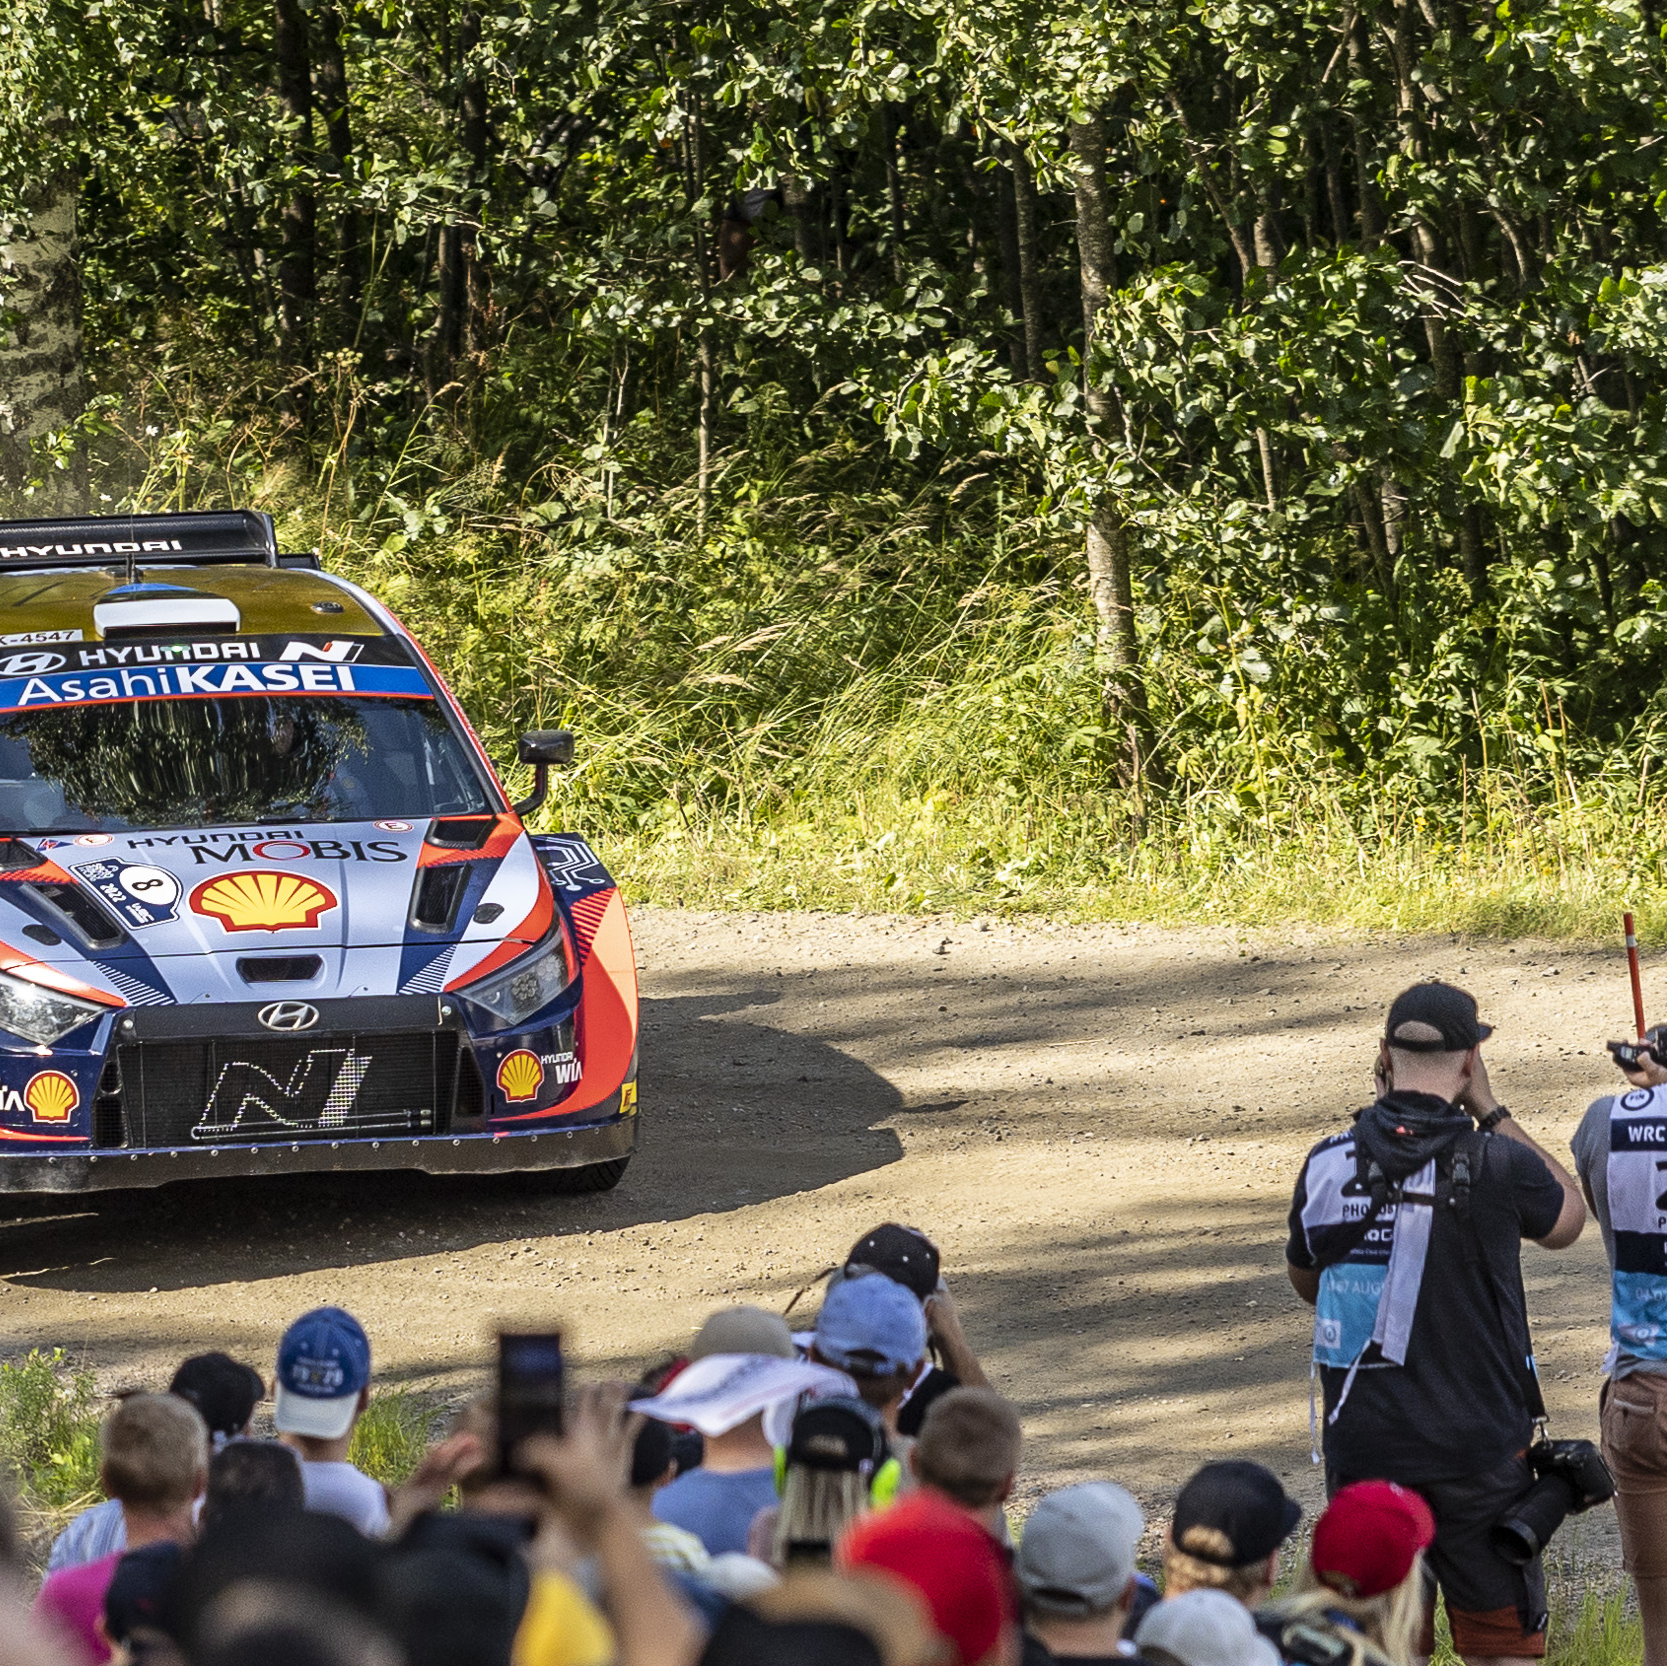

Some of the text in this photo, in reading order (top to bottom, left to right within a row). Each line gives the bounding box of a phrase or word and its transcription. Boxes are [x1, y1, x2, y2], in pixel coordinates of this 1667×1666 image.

[0, 539, 182, 559] HYUNDAI
[79, 641, 261, 667] HYUNDAI
[17, 663, 356, 706] AsahiKASEI
[126, 830, 306, 850] HYUNDAI
[189, 839, 409, 865] MOBIS
[131, 878, 164, 891] 8
[1628, 1124, 1666, 1143] WRC
